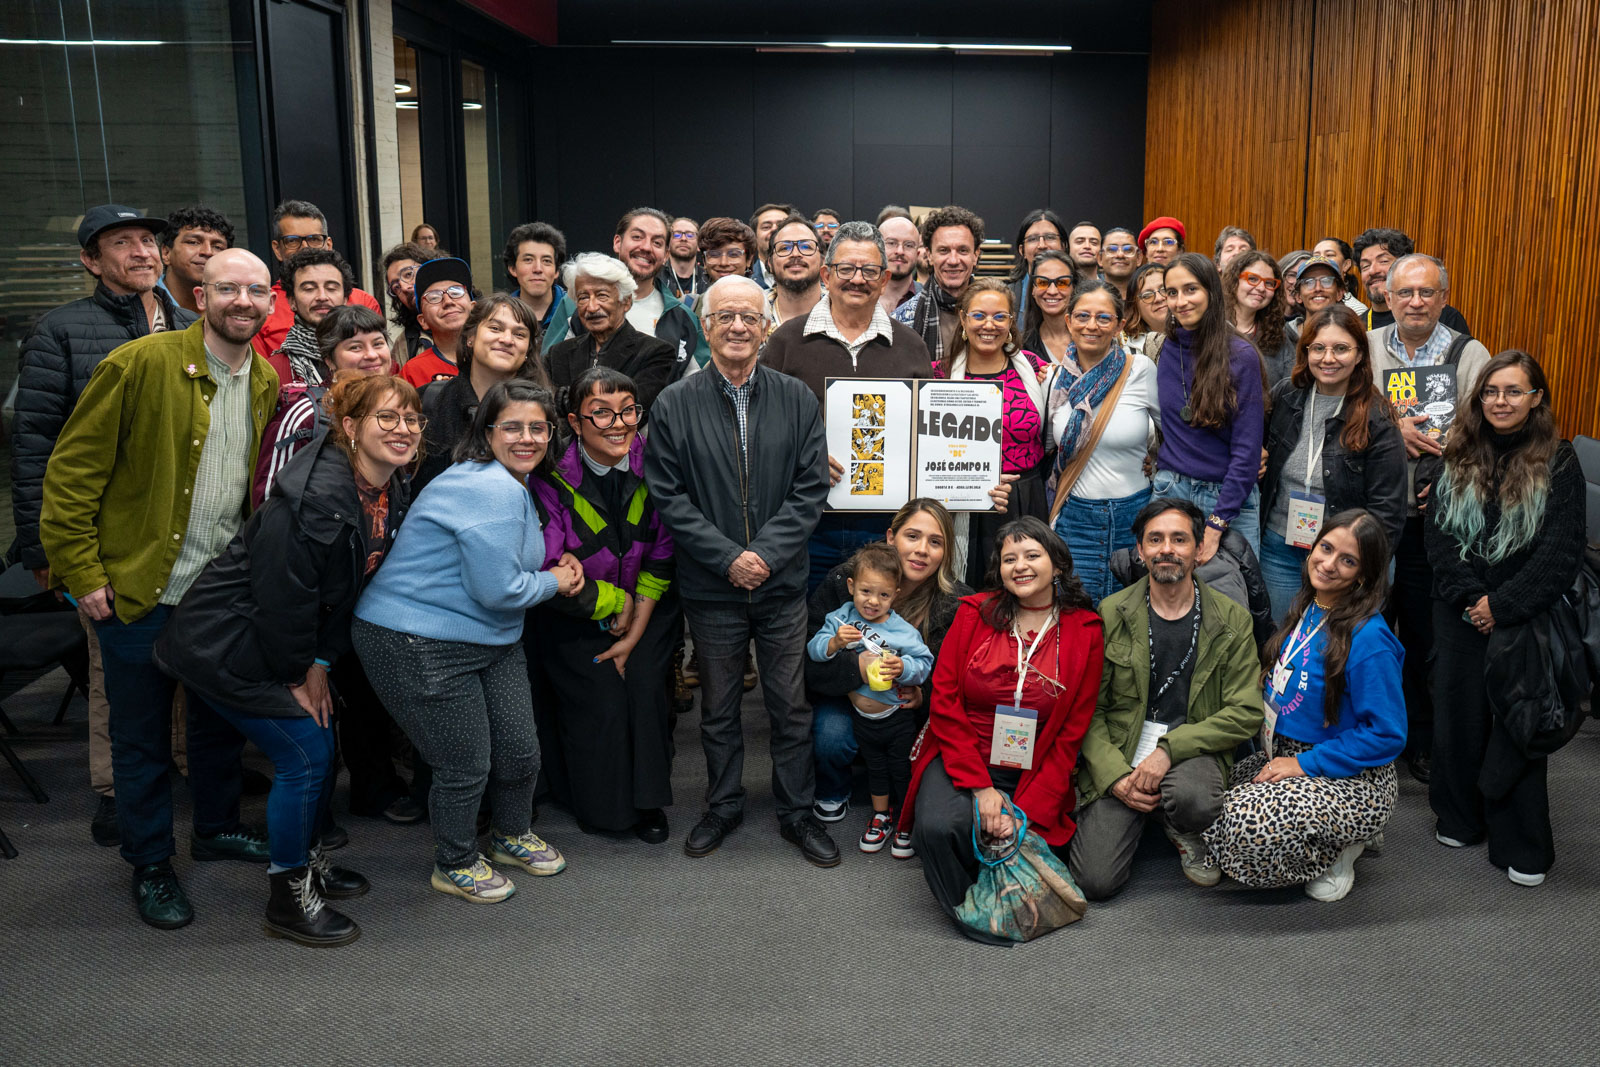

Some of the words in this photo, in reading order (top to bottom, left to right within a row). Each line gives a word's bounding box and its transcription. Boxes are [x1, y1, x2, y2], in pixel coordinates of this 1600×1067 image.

[1388, 371, 1416, 387] AN
[1388, 386, 1416, 403] TO
[918, 409, 1002, 444] LEGADO
[925, 459, 946, 471] JOSÉ
[948, 461, 981, 471] CAMPO
[849, 620, 888, 648] CKEY
[1298, 670, 1308, 691] DE
